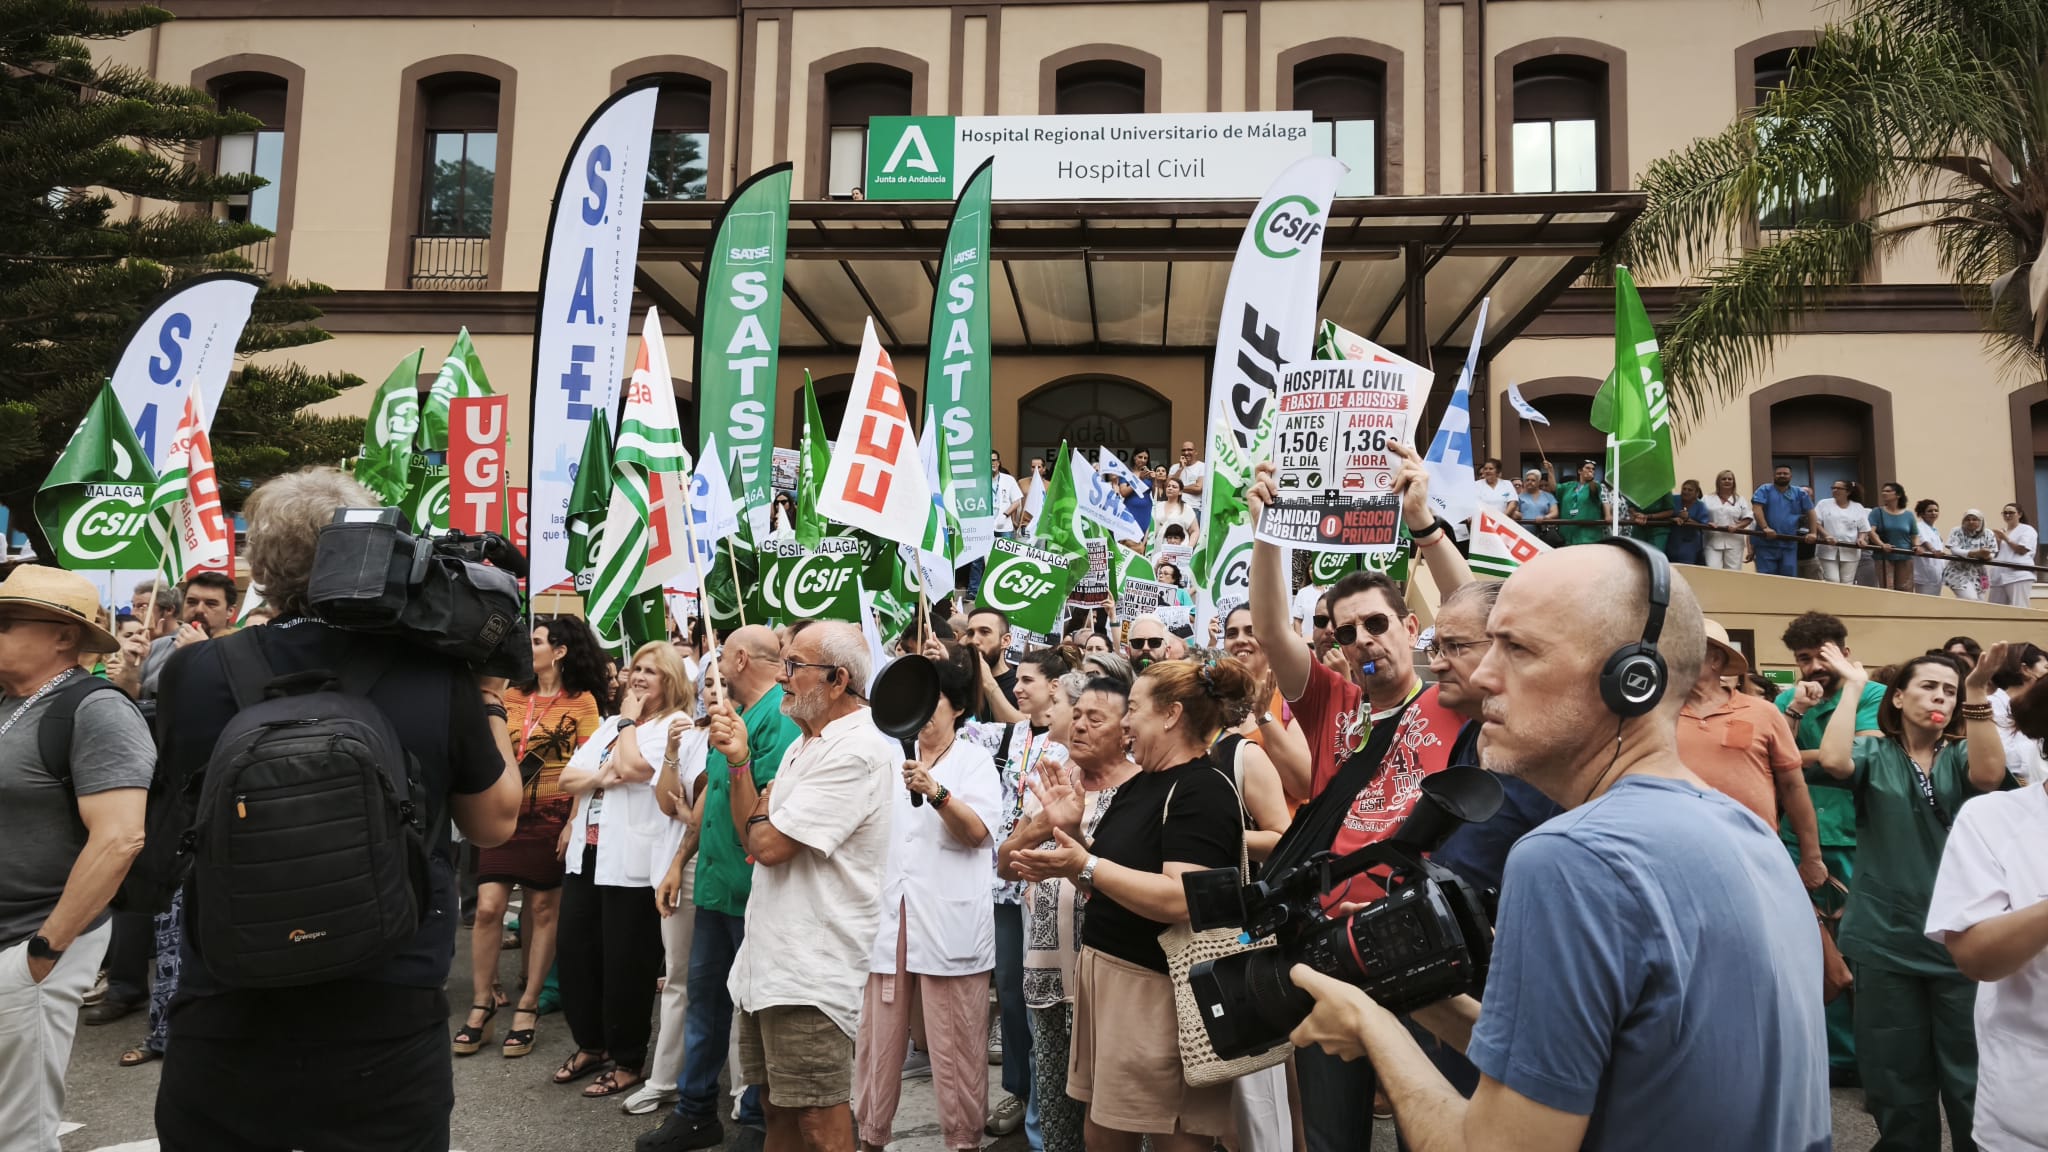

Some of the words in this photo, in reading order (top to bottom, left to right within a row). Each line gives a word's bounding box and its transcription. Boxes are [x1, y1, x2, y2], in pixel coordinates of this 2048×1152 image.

[962, 128, 1029, 144] Hospital
[1034, 127, 1105, 143] Regional
[1110, 125, 1218, 140] Universitario
[1223, 125, 1243, 138] de
[1247, 122, 1307, 141] Málaga
[874, 175, 896, 183] Junta
[897, 175, 907, 183] de
[908, 174, 946, 183] Andalucía
[1058, 158, 1151, 183] Hospital
[1157, 158, 1205, 178] Civil
[1267, 212, 1322, 246] CSIF
[730, 246, 770, 260] SATSE
[726, 270, 771, 483] SATSE
[942, 273, 977, 490] SATSE
[1231, 301, 1283, 449] SIF
[1283, 369, 1355, 393] HOSPITAL
[1362, 369, 1406, 392] CIVIL
[1285, 395, 1325, 412] ¡BASTA
[1328, 393, 1345, 408] DE
[1348, 392, 1401, 409] ABUSOS!
[1285, 415, 1325, 430] ANTES
[1348, 414, 1394, 428] AHORA
[1278, 431, 1329, 455] 1,50€
[1282, 456, 1296, 467] EL
[1299, 453, 1319, 467] DÍA
[1345, 454, 1388, 467] /HORA
[424, 465, 443, 477] SIF
[463, 404, 503, 534] UGT
[179, 499, 199, 552] álaga
[1266, 510, 1321, 526] SANIDAD
[1343, 511, 1395, 528] NEGOCIO
[542, 531, 560, 542] que
[1264, 521, 1318, 542] PÚBLICA
[1341, 527, 1393, 544] PRIVADO
[763, 540, 778, 551] CS
[779, 544, 805, 557] CSIF
[996, 538, 1022, 555] CSIF
[1320, 553, 1351, 568] CSIF
[797, 567, 854, 594] CSIF
[998, 569, 1056, 600] CSIF
[1126, 581, 1134, 589] LA
[1135, 583, 1159, 593] QUIMIO
[1125, 593, 1135, 602] UN
[1136, 595, 1157, 607] LUJO
[1359, 796, 1386, 812] EST
